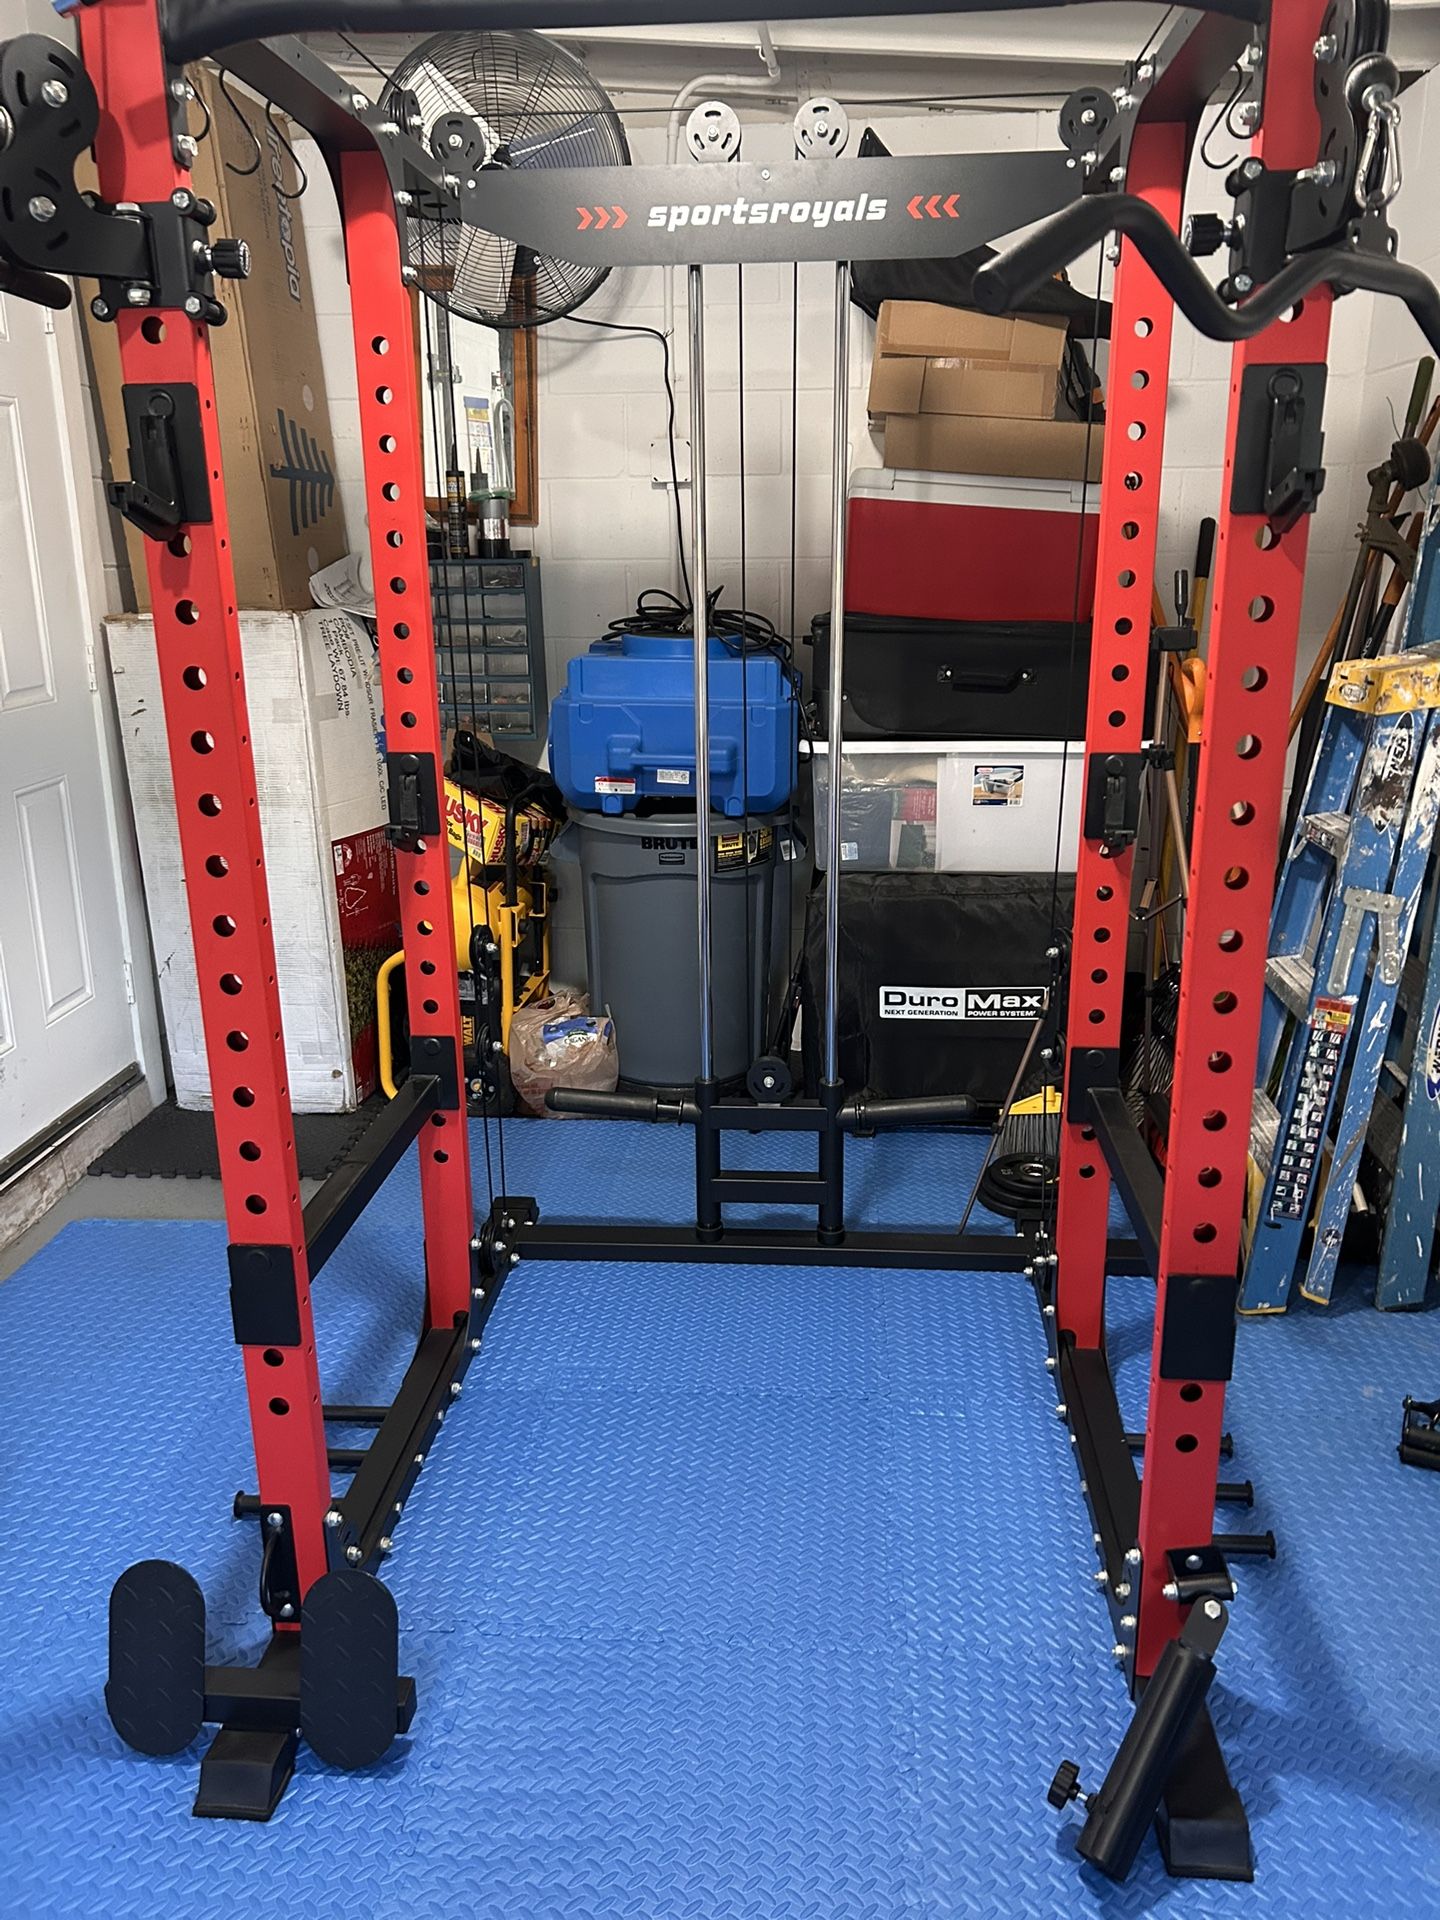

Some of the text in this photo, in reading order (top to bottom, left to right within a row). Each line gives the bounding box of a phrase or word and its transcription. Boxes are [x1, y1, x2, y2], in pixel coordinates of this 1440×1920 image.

[647, 193, 888, 232] sportsroyals
[318, 621, 344, 712] TREE LAYDOWN
[332, 617, 357, 679] CAMBODIA
[884, 991, 1042, 1010] Duro Max
